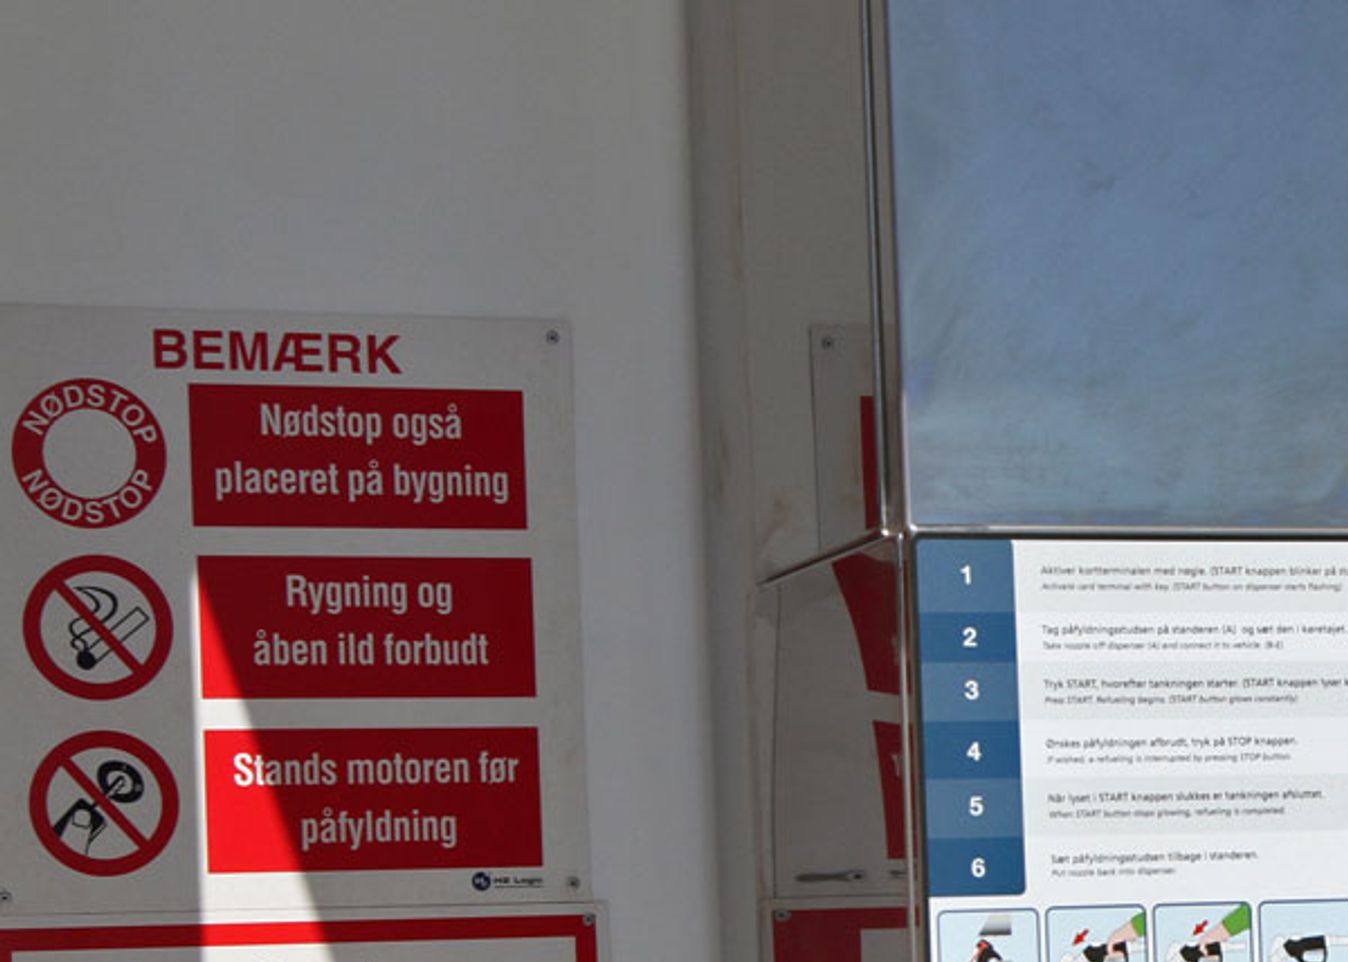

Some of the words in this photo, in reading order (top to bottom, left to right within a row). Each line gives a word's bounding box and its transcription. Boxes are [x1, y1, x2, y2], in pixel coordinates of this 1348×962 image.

[153, 329, 402, 375] BEMÆRK
[22, 383, 157, 446] NØDSTOP
[260, 404, 381, 445] Nødstop
[393, 404, 462, 446] også
[21, 468, 155, 524] NØDSTOP
[215, 463, 339, 500] placeret
[348, 460, 385, 497] på
[394, 464, 509, 504] bygning
[960, 566, 973, 584] 1
[286, 574, 409, 613] Rygning
[418, 581, 453, 614] og
[254, 630, 327, 666] åben
[338, 633, 374, 665] ild
[384, 633, 489, 665] forbudt
[961, 628, 977, 648] 2
[964, 681, 979, 700] 3
[1044, 679, 1063, 691] Tryk
[967, 742, 981, 760] 4
[1213, 736, 1225, 747] på
[1227, 736, 1252, 747] STOP
[233, 752, 337, 788] Stands
[347, 752, 469, 786] motoren
[479, 750, 519, 783] før
[969, 797, 983, 816] 5
[1099, 791, 1129, 802] START
[301, 808, 458, 851] påfyldning
[970, 858, 985, 876] 6
